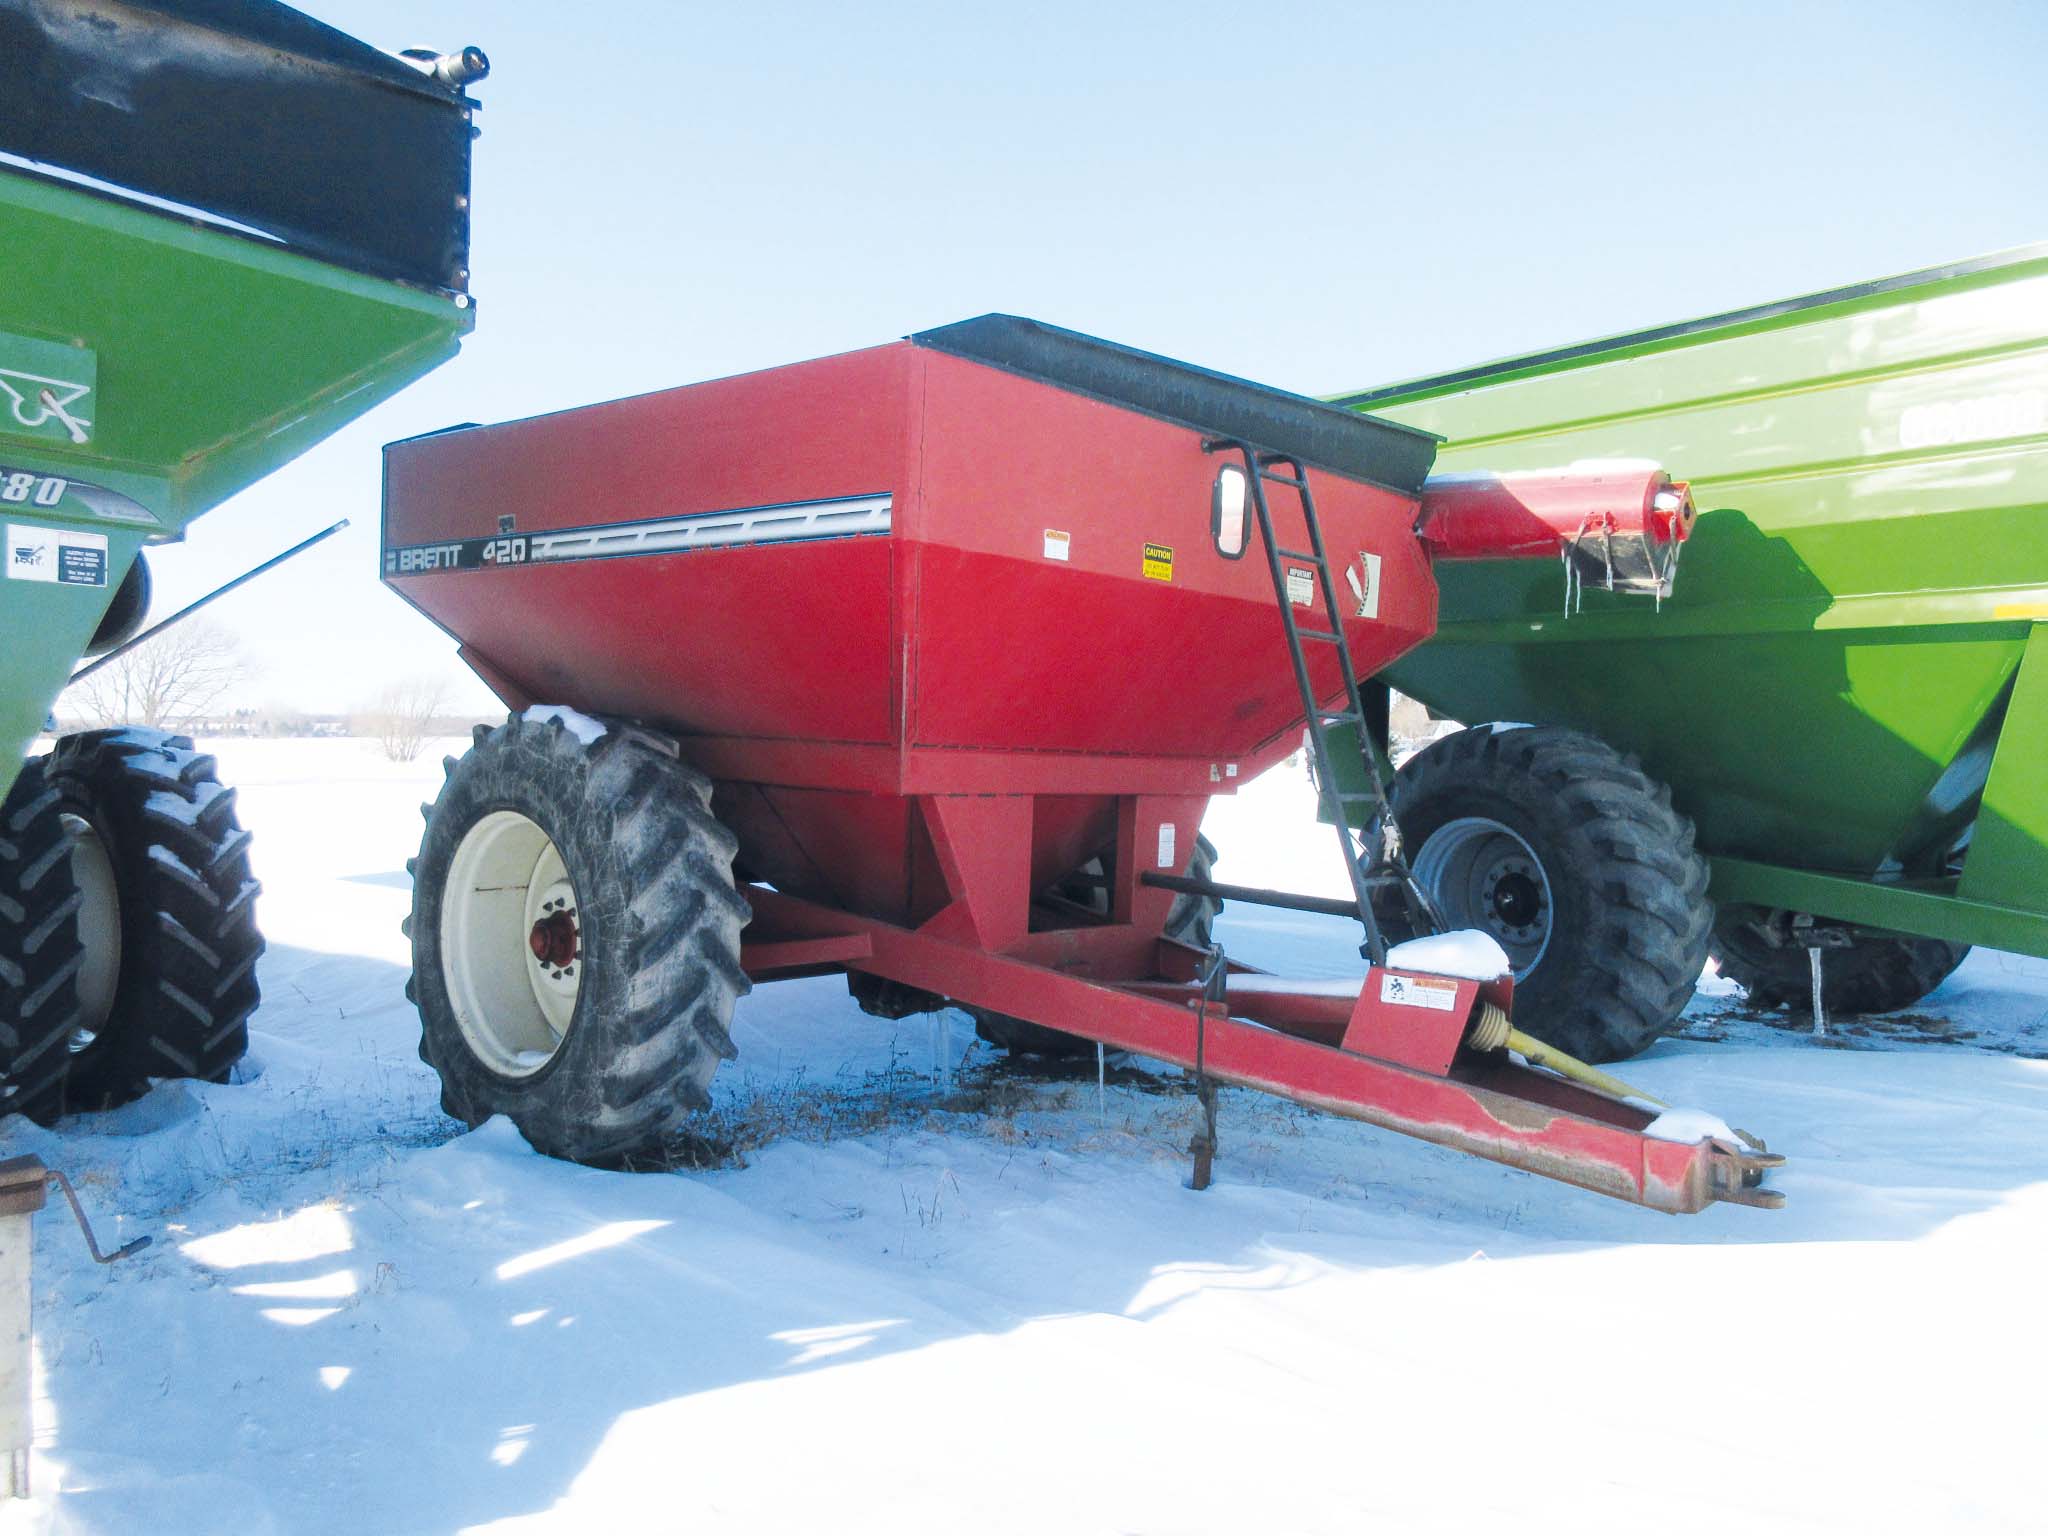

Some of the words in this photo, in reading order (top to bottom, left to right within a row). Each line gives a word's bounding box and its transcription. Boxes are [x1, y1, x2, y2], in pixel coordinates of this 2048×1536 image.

[0, 471, 67, 505] 80
[400, 544, 463, 571] BRENT
[482, 538, 526, 563] 420
[1145, 546, 1171, 560] CAUTION
